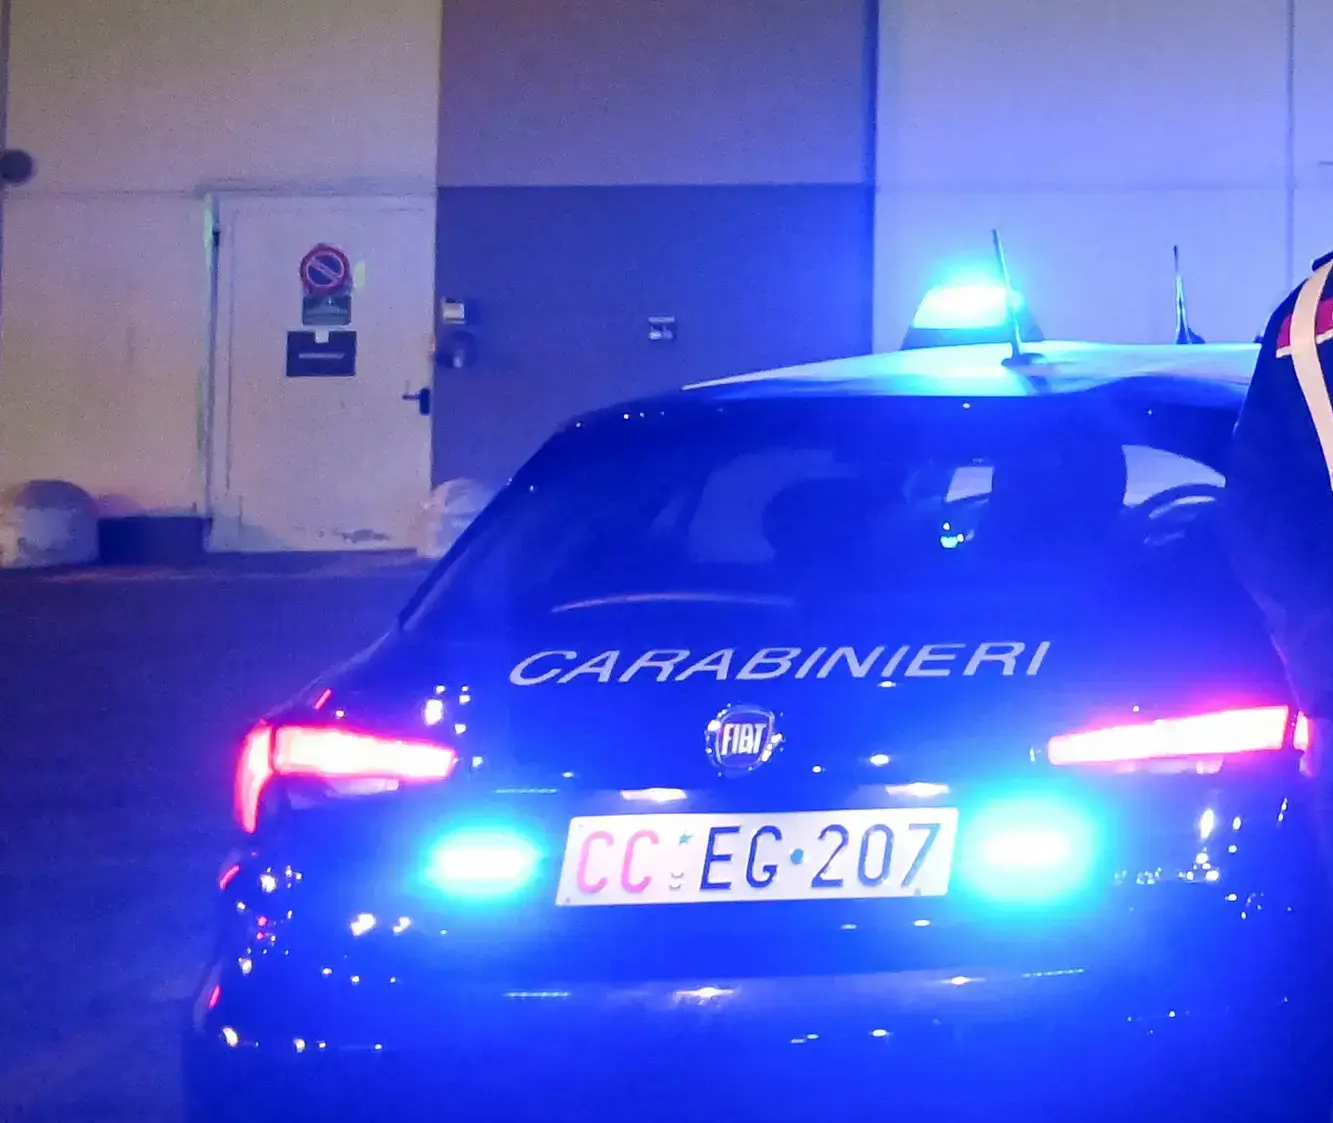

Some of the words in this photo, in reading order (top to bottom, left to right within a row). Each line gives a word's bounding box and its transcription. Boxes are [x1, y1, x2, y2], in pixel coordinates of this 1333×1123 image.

[508, 640, 1051, 687] CARABINIERI
[720, 722, 768, 756] FIAT
[576, 829, 660, 894] CC
